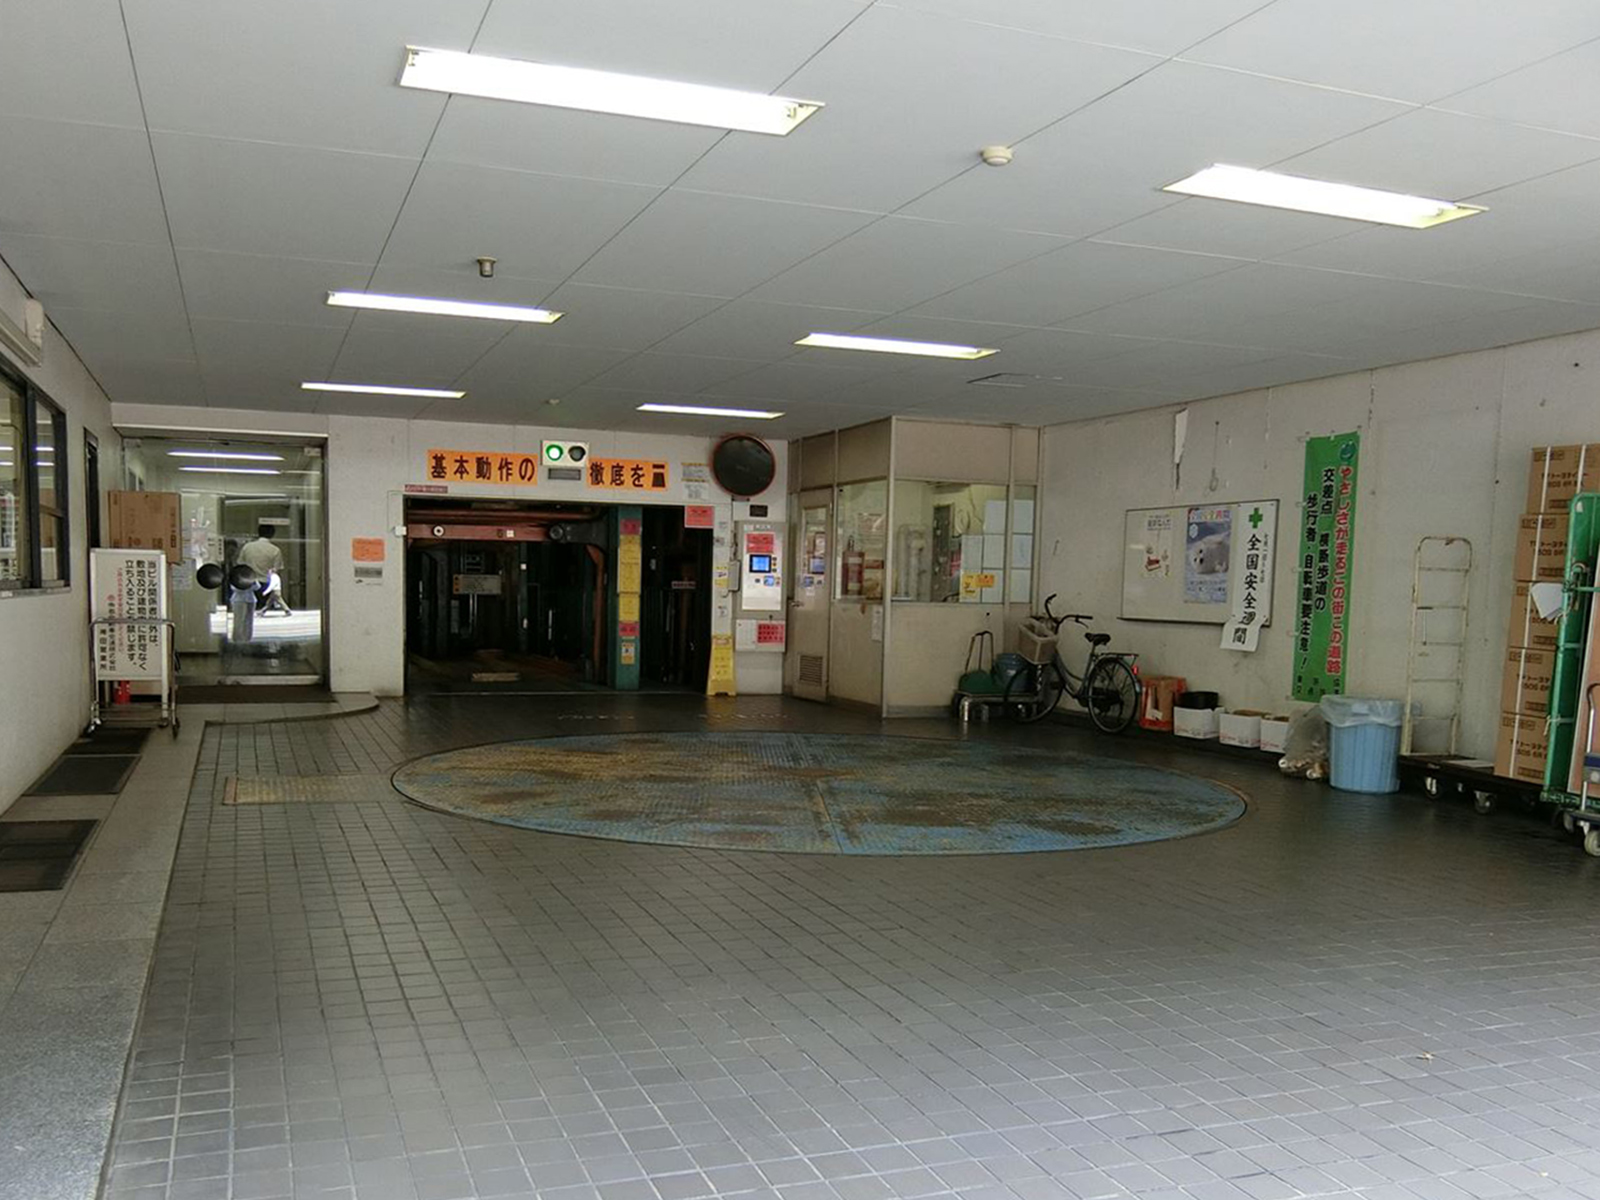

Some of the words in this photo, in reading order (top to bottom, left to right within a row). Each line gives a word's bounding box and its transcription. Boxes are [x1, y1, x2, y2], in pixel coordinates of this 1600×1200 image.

[430, 453, 536, 482] 基本動作の
[1320, 467, 1335, 516] 交差点
[1232, 533, 1262, 645] 全国安全週間
